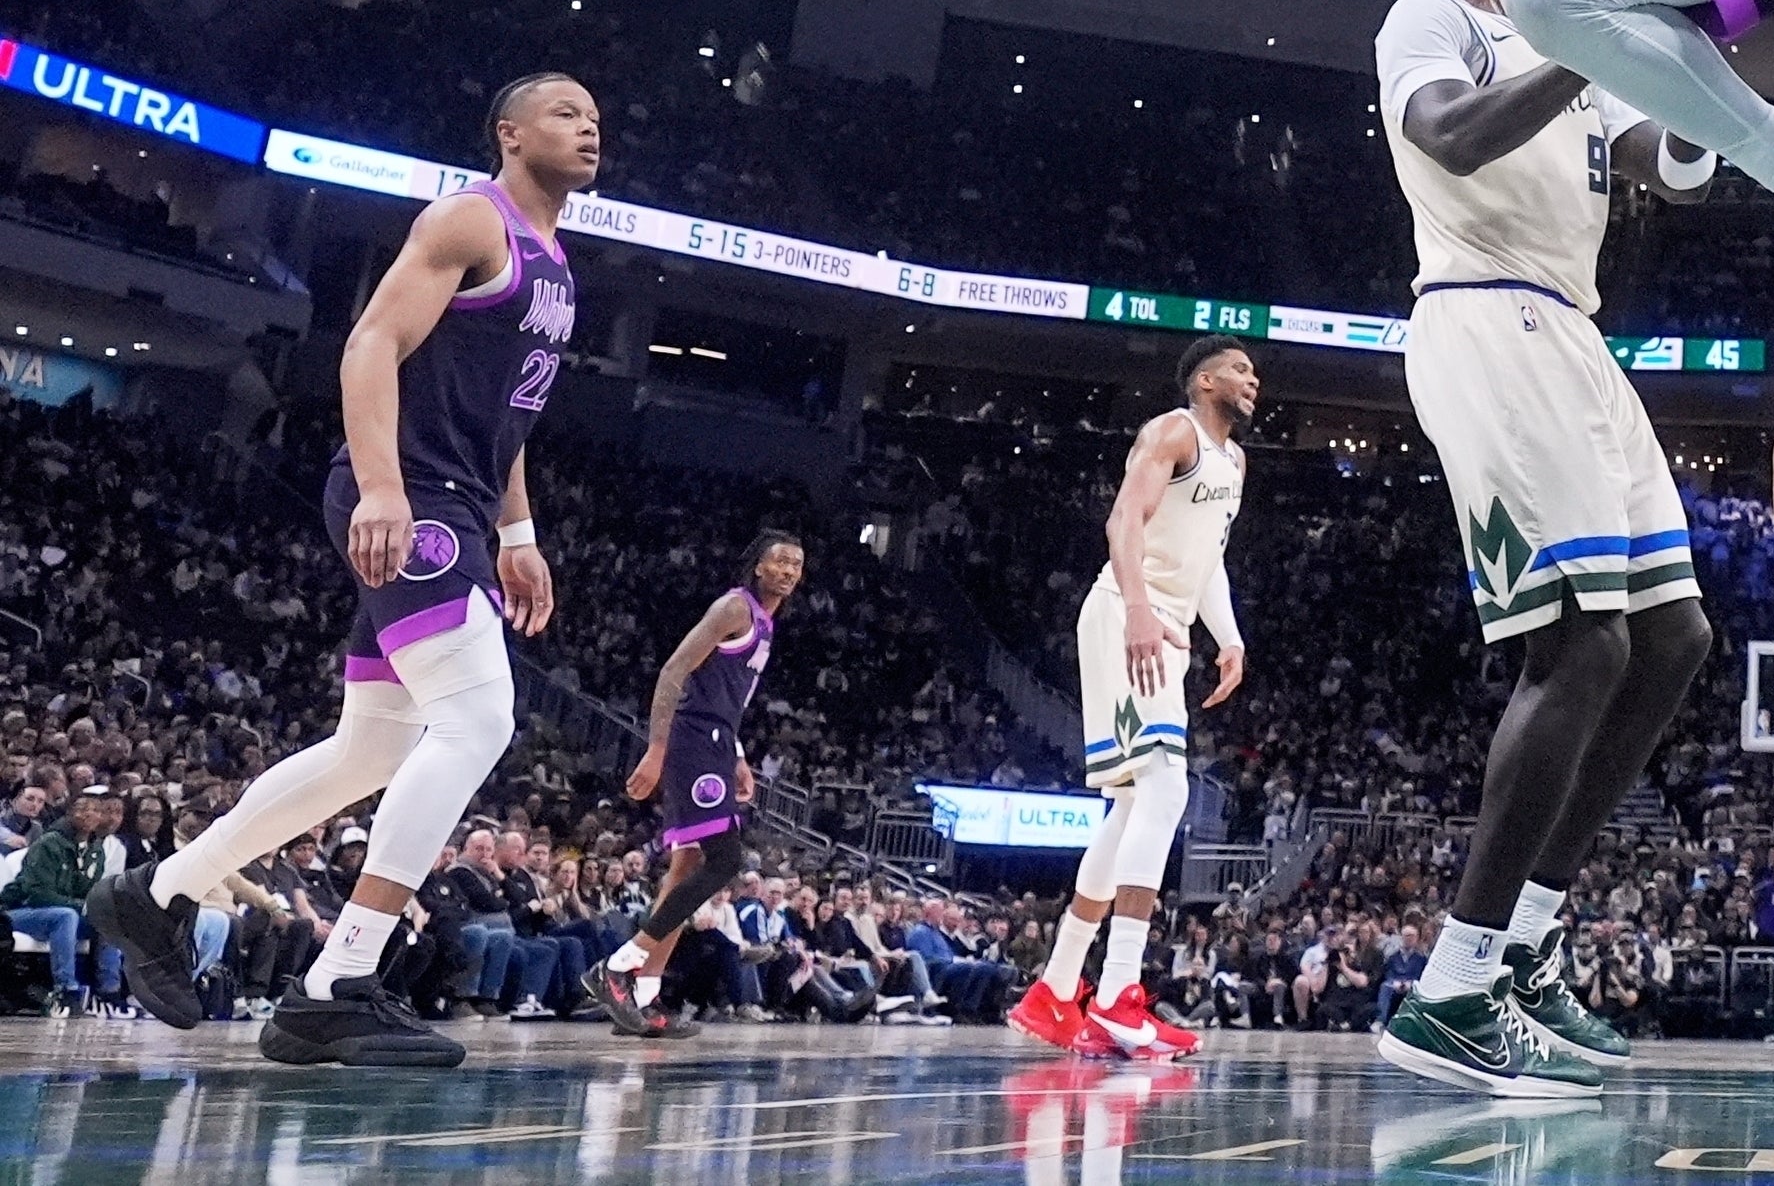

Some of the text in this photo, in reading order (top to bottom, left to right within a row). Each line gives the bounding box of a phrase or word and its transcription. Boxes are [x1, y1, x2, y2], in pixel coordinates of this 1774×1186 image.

[32, 54, 201, 144] ULTRA
[330, 154, 406, 183] Gallagher
[1587, 133, 1608, 196] 9
[579, 202, 637, 234] GOALS
[688, 223, 748, 260] 5-15
[753, 239, 852, 280] 3-POINTERS
[897, 267, 937, 299] 6-8
[957, 279, 1070, 312] FREE THROWS
[1104, 292, 1125, 322] 4
[1128, 296, 1161, 322] TOL
[1194, 300, 1213, 331] 2
[1218, 306, 1252, 331] FLS
[1704, 339, 1741, 370] 45
[1018, 808, 1090, 829] ULTRA
